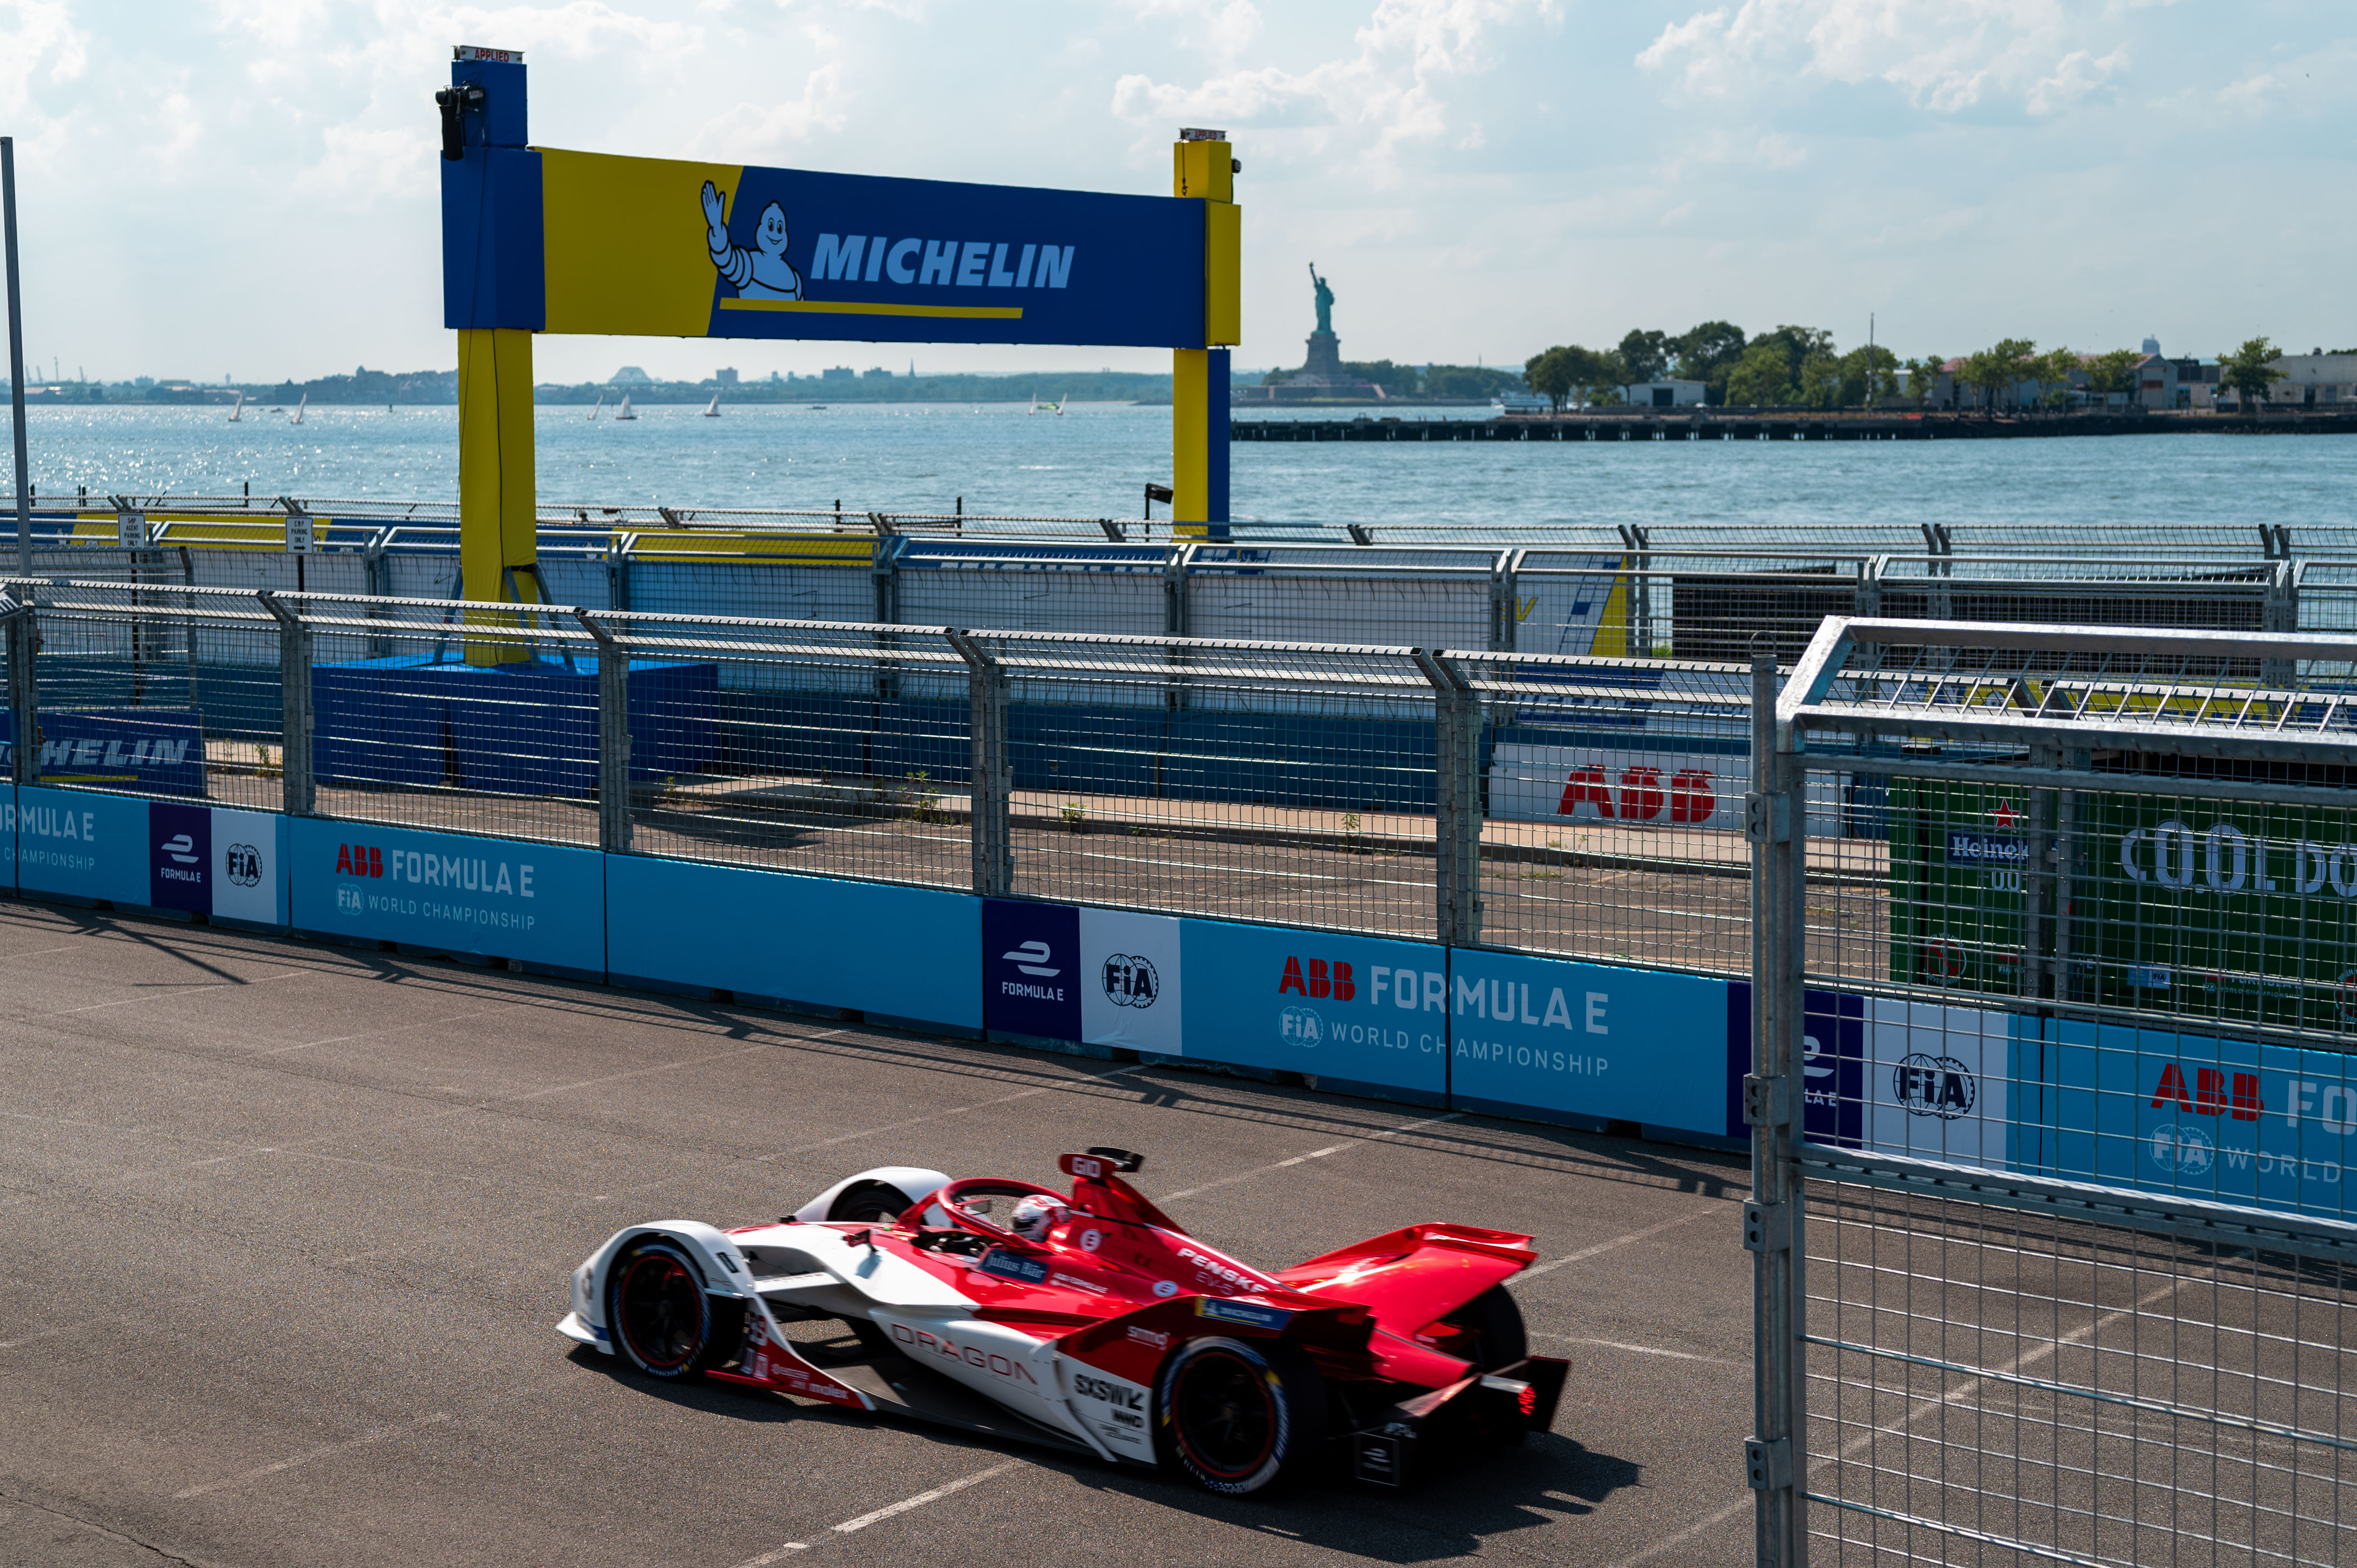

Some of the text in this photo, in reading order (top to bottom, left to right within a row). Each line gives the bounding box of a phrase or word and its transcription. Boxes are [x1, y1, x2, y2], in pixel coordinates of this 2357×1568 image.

[475, 48, 509, 62] APPLIED
[811, 233, 1075, 288] MICHELIN
[1557, 764, 1715, 822] ABB
[0, 803, 94, 842] RMULA E
[4, 847, 94, 870] CHAMPIONSHIP
[161, 868, 201, 882] FORMULA E
[336, 843, 534, 898] ABB FORMULA E
[369, 895, 416, 914] WORLD
[423, 902, 534, 930] CHAMPIONSHIP
[1002, 982, 1063, 1001] FORMULA E
[1279, 956, 1608, 1035] ABB FORMULA E
[1331, 1023, 1409, 1049] WORLD
[1420, 1034, 1608, 1076] CHAMPIONSHIP
[2151, 1063, 2264, 1121] ABB
[2227, 1146, 2341, 1183] WORLD
[984, 1253, 1020, 1271] Julius
[1177, 1248, 1270, 1293] PENSKE
[648, 1368, 678, 1377] MICHELIN
[891, 1324, 1038, 1385] DRAGON
